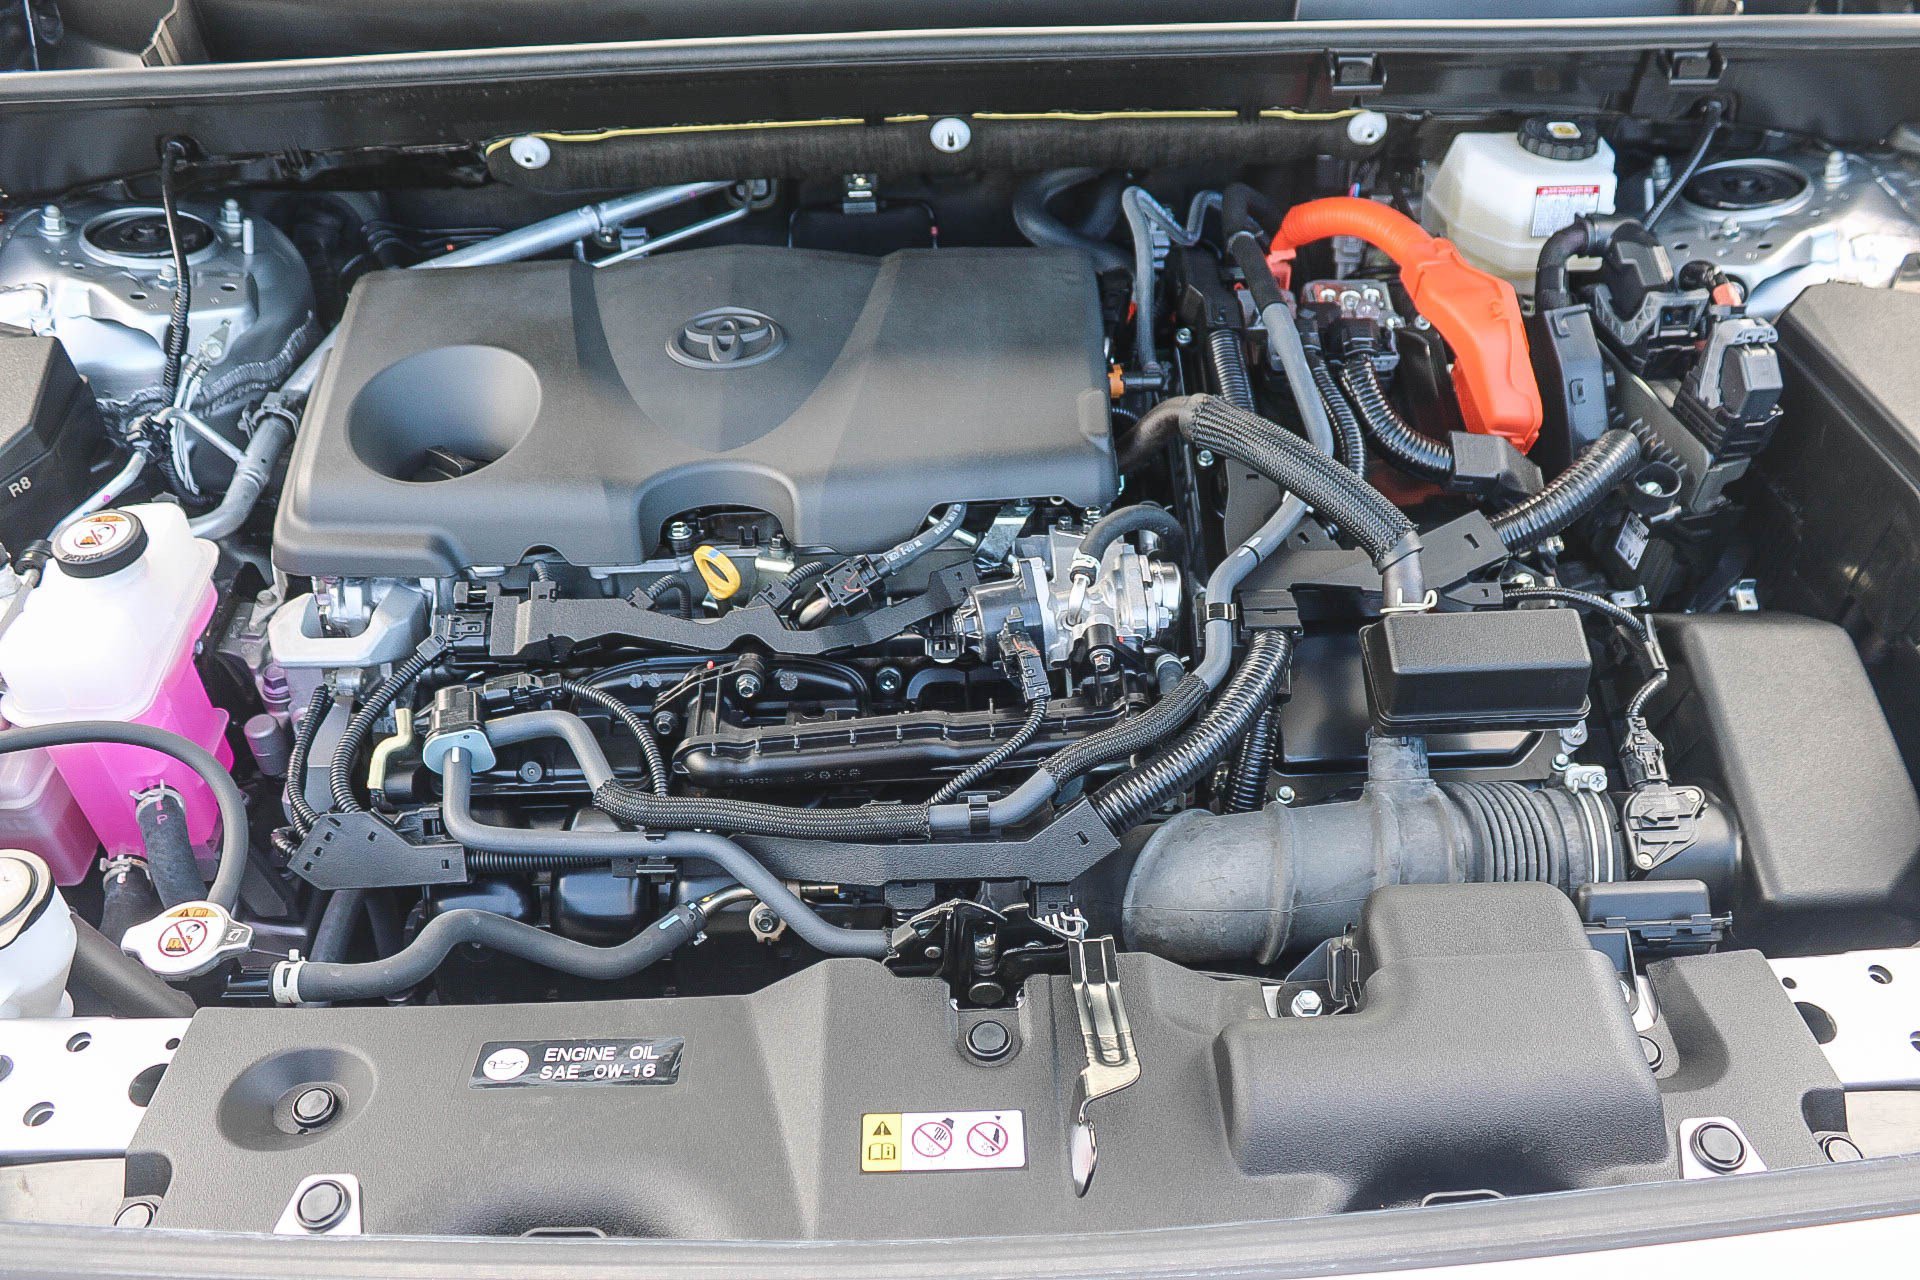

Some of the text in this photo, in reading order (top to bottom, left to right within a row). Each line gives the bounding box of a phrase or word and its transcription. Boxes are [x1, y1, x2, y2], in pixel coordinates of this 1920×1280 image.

[8, 476, 31, 498] R8
[544, 1045, 660, 1062] ENGINE OIL
[539, 1063, 657, 1080] SAE 0W-16
